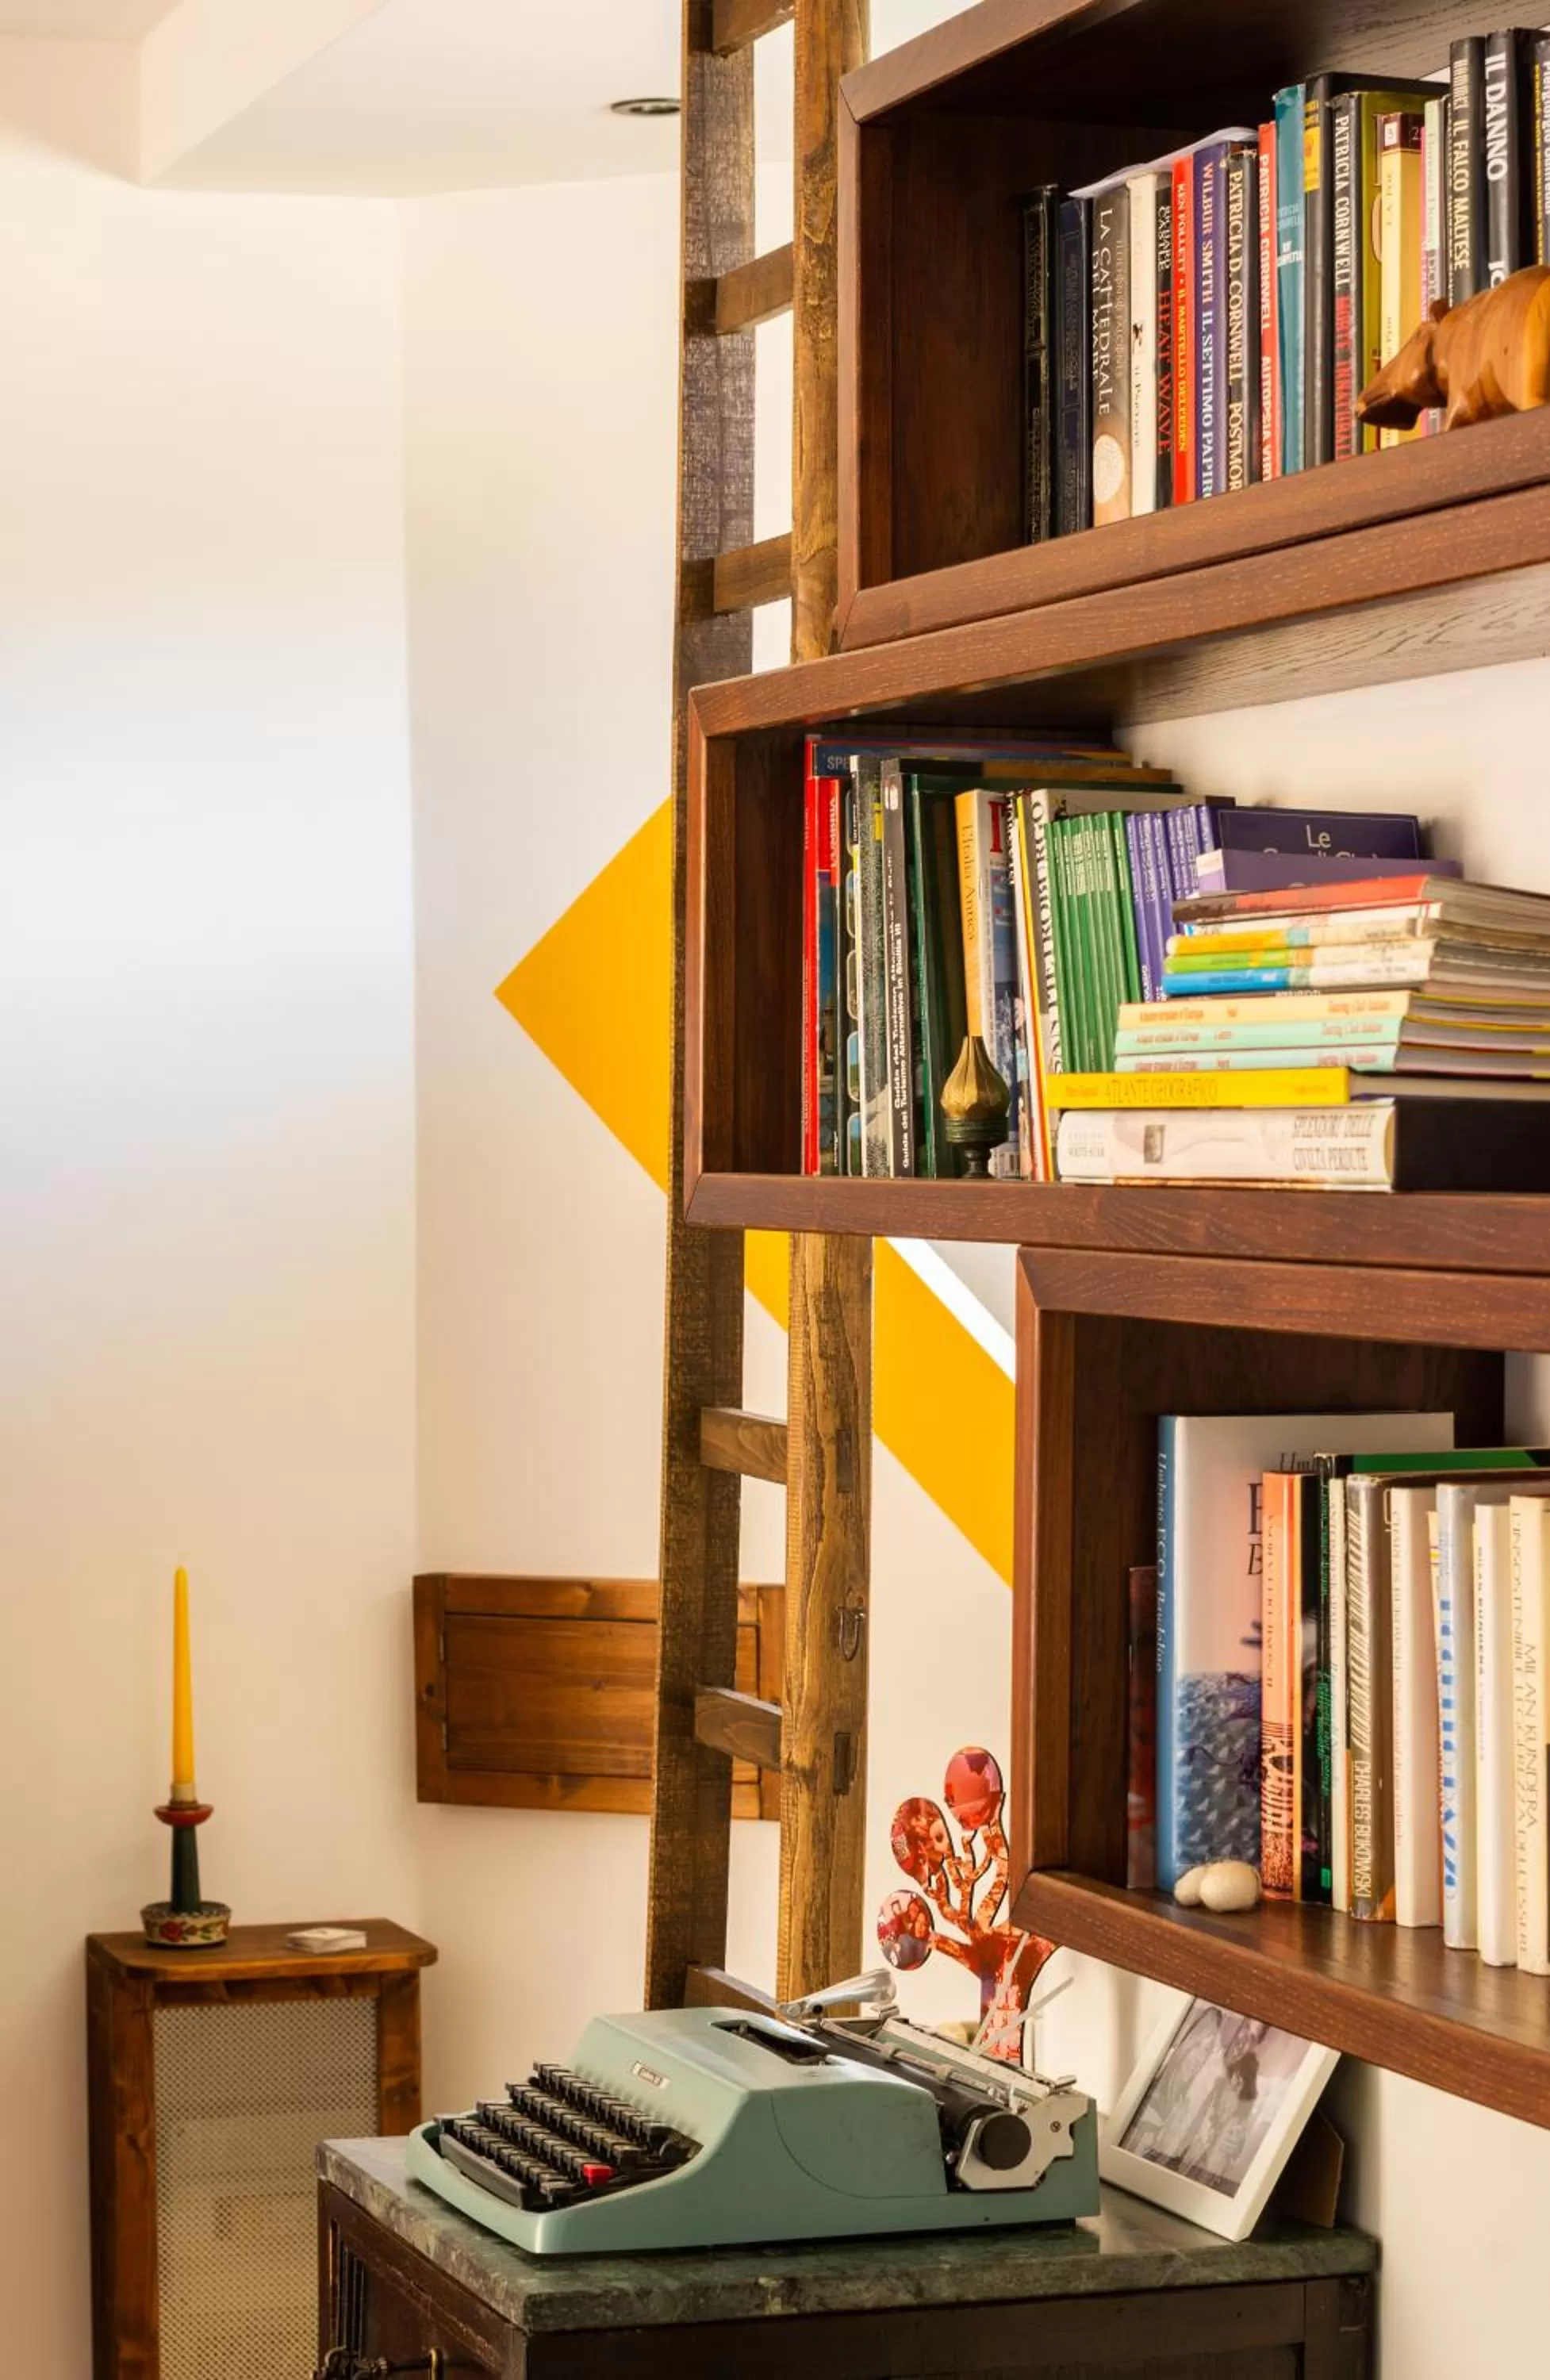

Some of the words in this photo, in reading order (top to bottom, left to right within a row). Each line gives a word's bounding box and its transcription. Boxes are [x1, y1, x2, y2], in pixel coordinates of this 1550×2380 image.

[1484, 52, 1506, 80] IL
[1334, 114, 1350, 191] PATRICIA
[1453, 119, 1469, 137] IL
[1485, 81, 1509, 182] DANNO
[1176, 183, 1187, 209] KEN
[1202, 161, 1214, 236] WILBUR
[1259, 153, 1271, 234] PATRICIA
[1453, 140, 1469, 191] FALCO
[1099, 208, 1113, 241] LA
[1157, 205, 1166, 272] CASTLE
[1176, 213, 1187, 273] FOLLETT
[1228, 170, 1244, 251] PATRICIA
[1334, 195, 1351, 290] CORNWELL
[1453, 197, 1470, 271] MALTESE
[1202, 240, 1214, 305] SMITH
[1228, 257, 1244, 279] D.
[1260, 237, 1271, 336] CORNWELL
[1098, 247, 1114, 416] CATTEDRALE
[1157, 290, 1172, 364] HEAT
[1177, 305, 1188, 379] MARTELLO
[1202, 309, 1214, 332] IL
[1228, 280, 1244, 387] CORNWELL
[1157, 373, 1172, 456] WAVE
[1202, 333, 1214, 428] SETTIMO
[1260, 355, 1272, 441] AUTOPSIA
[1306, 824, 1332, 848] Le
[898, 1059, 908, 1109] Turismo
[1103, 1079, 1149, 1104] ATLANTE
[901, 1132, 911, 1169] Guida
[1157, 1452, 1168, 1521] Umberto
[1157, 1526, 1167, 1578] ECO
[1525, 1644, 1537, 1718] MILAN
[1354, 1758, 1372, 1819] CHARLES
[1525, 1725, 1539, 1829] KUNDERA
[1354, 1823, 1372, 1898] BUKOWSKI
